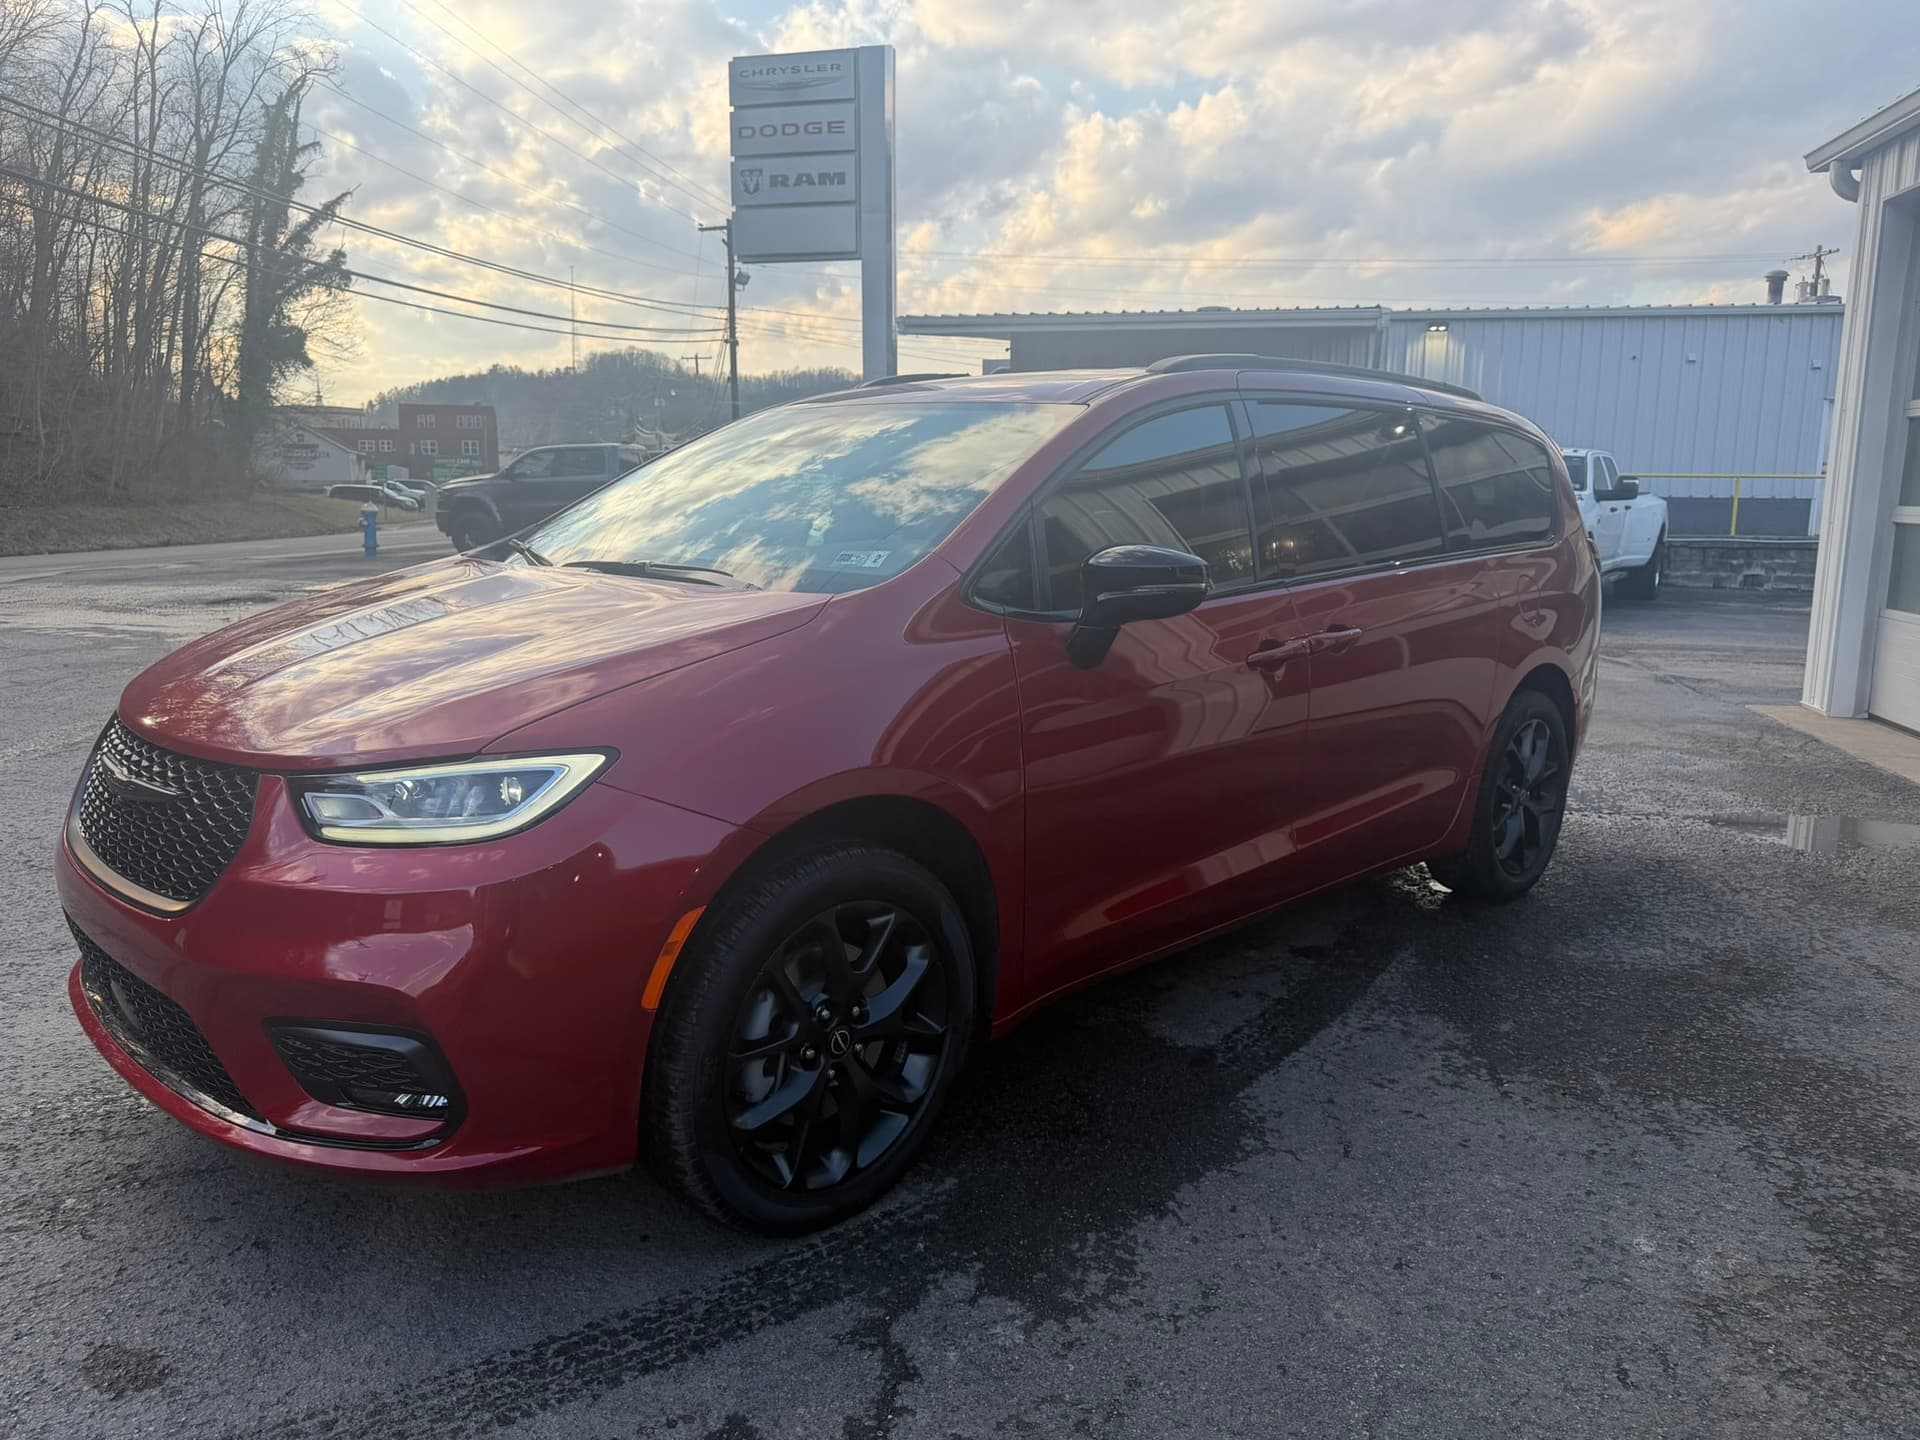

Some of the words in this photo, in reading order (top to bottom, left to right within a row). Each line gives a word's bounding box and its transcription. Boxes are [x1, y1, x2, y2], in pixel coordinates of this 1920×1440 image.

[739, 63, 842, 78] CHRYSLER
[737, 120, 846, 139] DODGE
[769, 172, 846, 188] RAM
